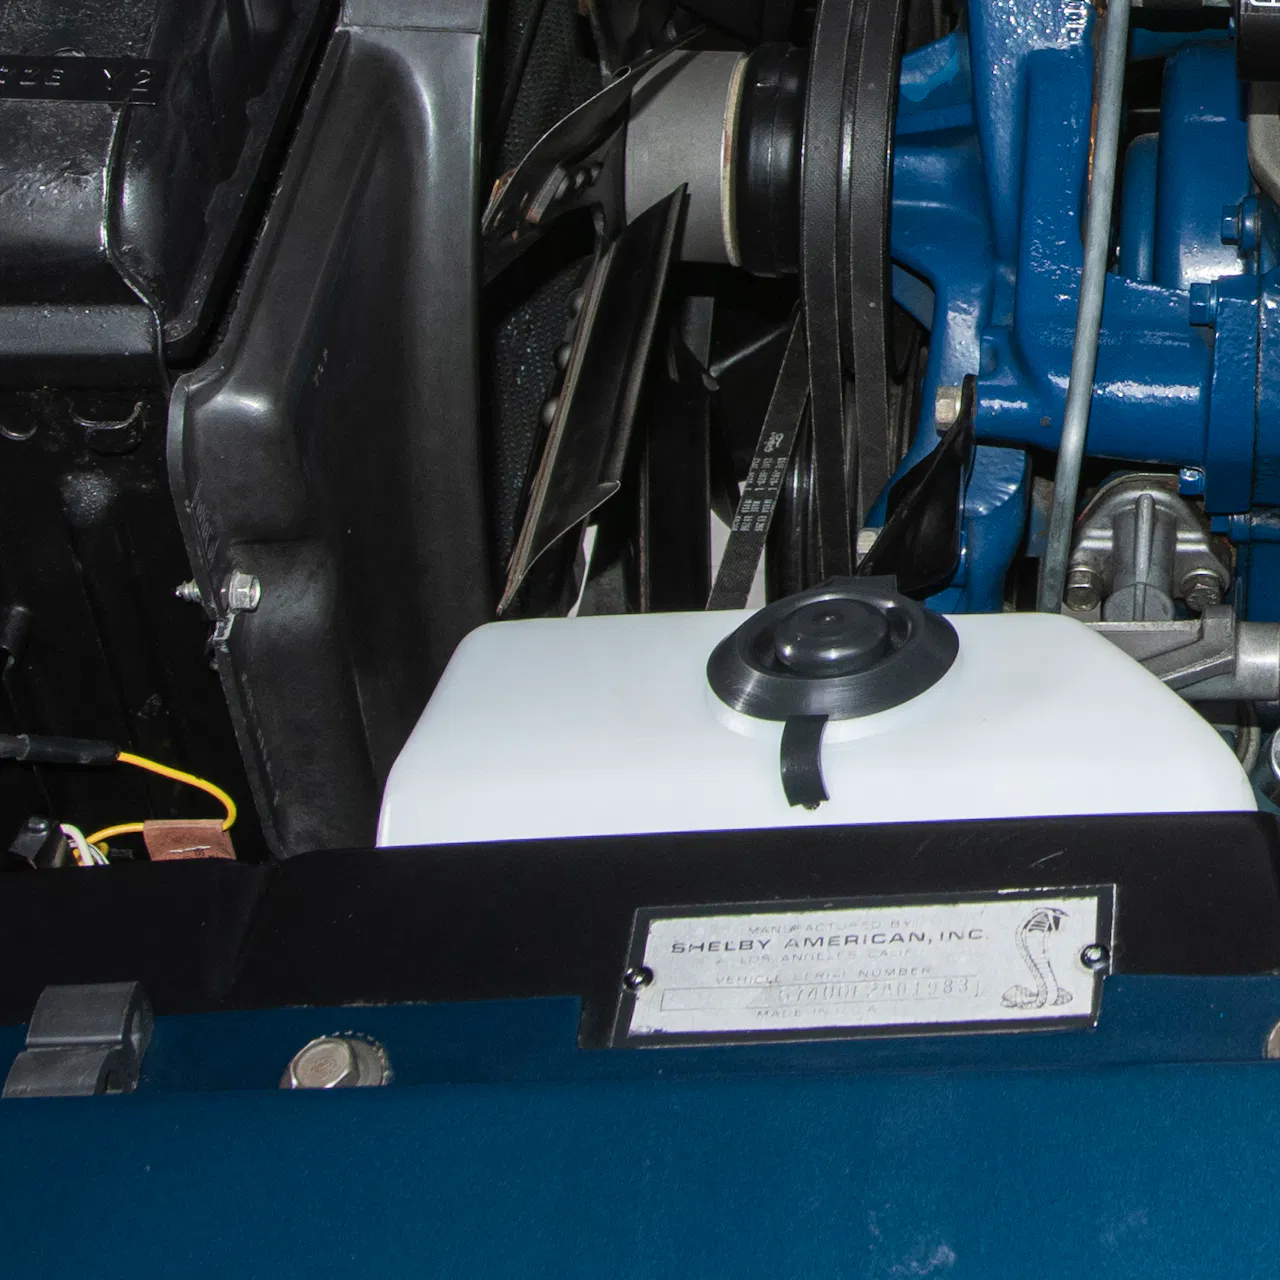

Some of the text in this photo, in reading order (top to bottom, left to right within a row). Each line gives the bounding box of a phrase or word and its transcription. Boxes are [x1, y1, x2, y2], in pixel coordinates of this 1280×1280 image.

[671, 927, 990, 954] SHELBY AMERICAN, INC.
[859, 967, 933, 978] NUMBER
